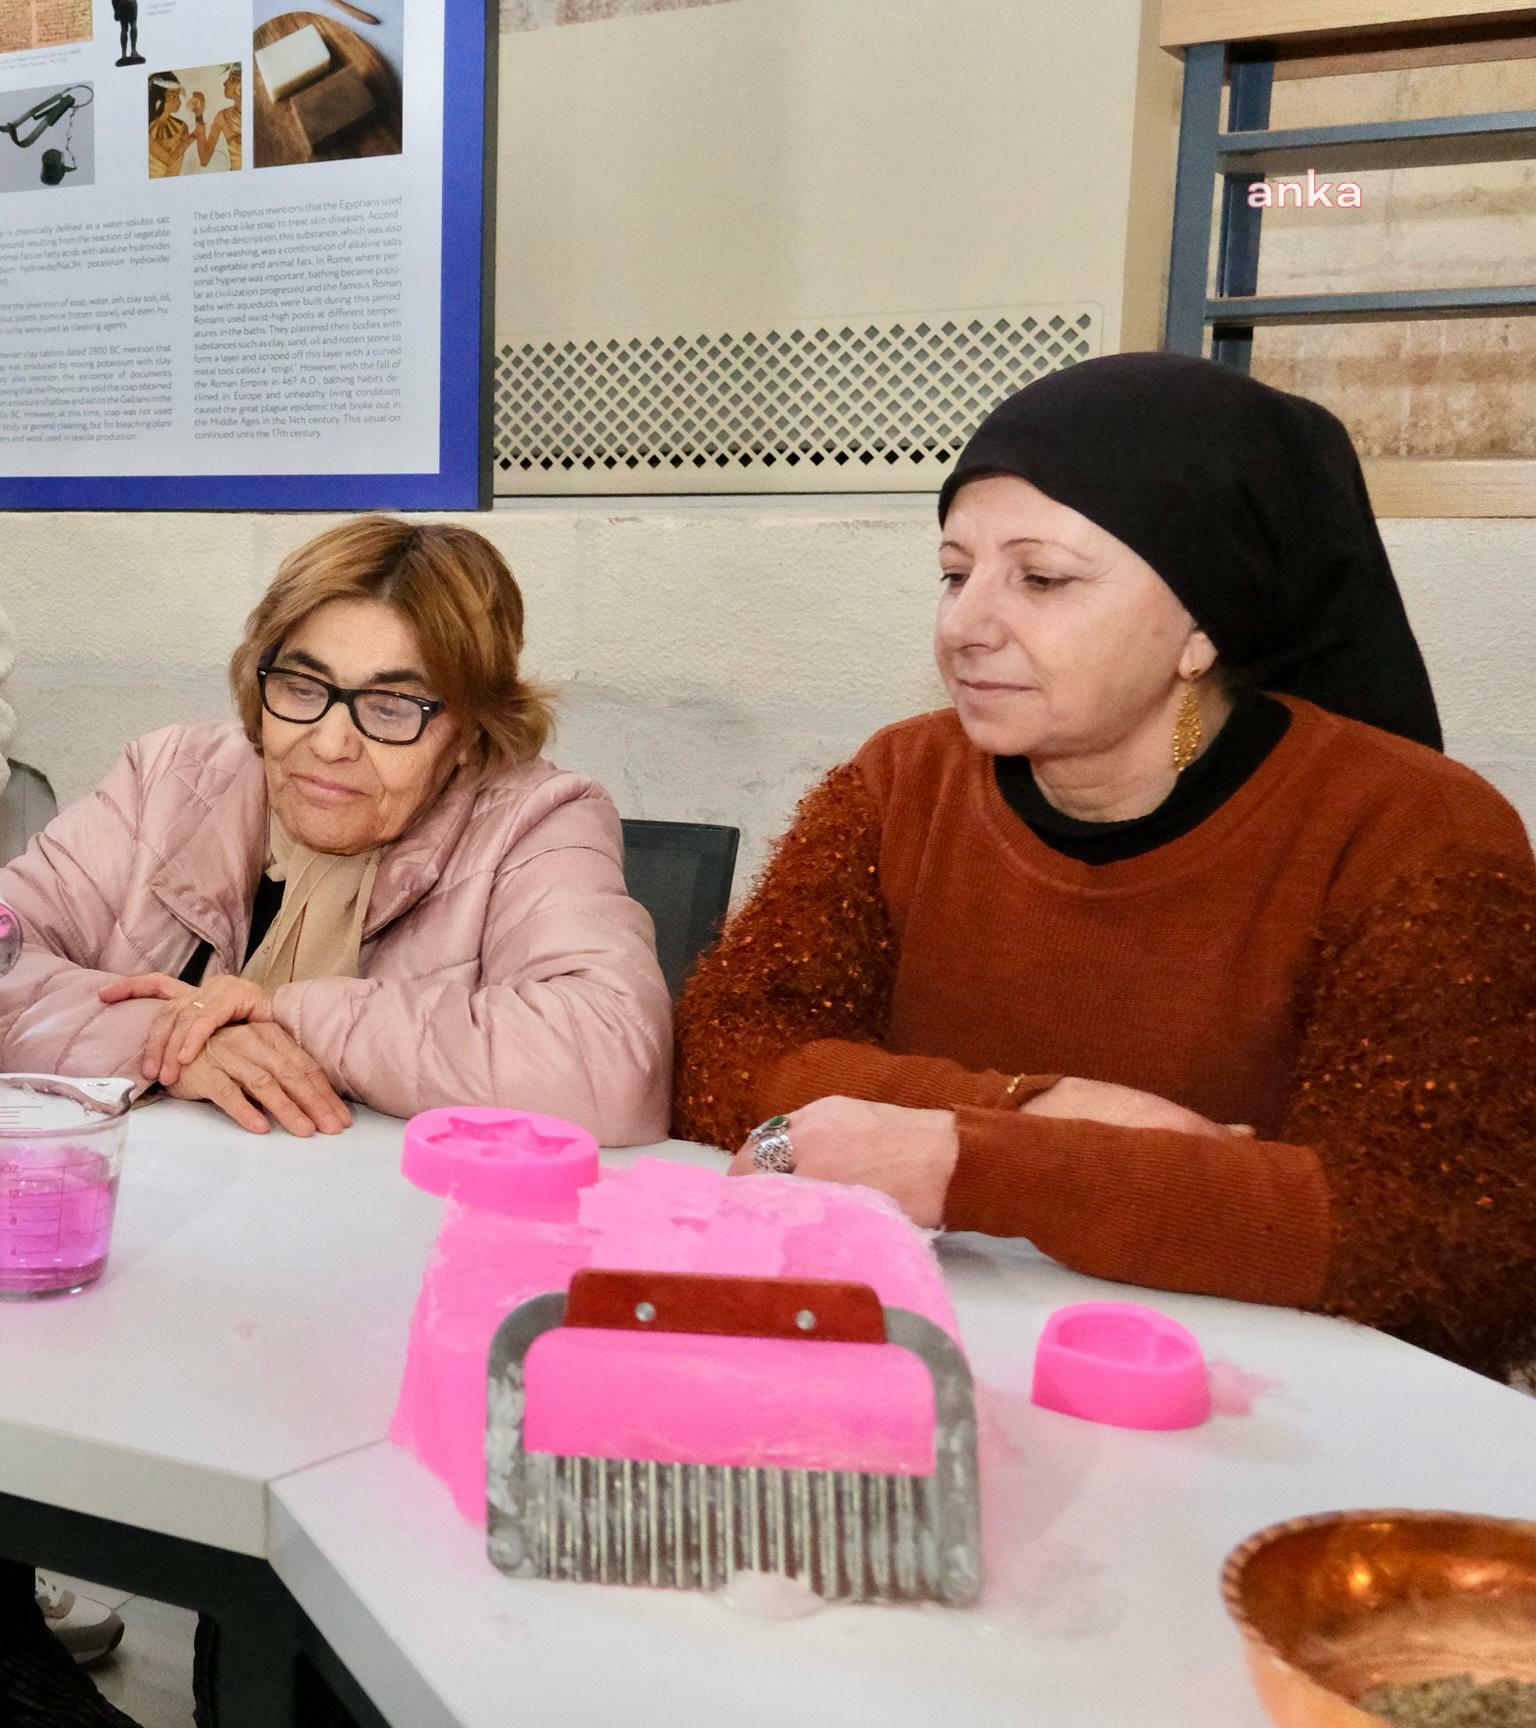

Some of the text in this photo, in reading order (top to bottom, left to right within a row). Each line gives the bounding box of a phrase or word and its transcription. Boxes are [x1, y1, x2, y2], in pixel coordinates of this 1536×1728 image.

[193, 196, 402, 221] The Papyrus mentions that the Egyptians used
[199, 222, 239, 233] substance
[256, 221, 275, 231] soap
[277, 219, 287, 228] to
[288, 217, 308, 227] treat
[216, 236, 229, 245] the
[279, 231, 294, 241] this
[340, 226, 365, 236] which
[384, 223, 401, 233] also
[193, 250, 212, 260] used
[213, 249, 224, 258] for
[283, 241, 335, 254] combination
[337, 241, 346, 250] of
[193, 263, 208, 272] and
[209, 260, 248, 274] vegetable
[250, 259, 265, 269] and
[267, 258, 293, 268] animal
[315, 256, 324, 265] In
[354, 252, 380, 262] where
[193, 276, 213, 285] sonal
[216, 274, 246, 286] hygiene
[307, 268, 338, 281] bathing
[340, 266, 373, 277] became
[193, 289, 203, 298] lar
[260, 283, 304, 297] progressed
[306, 282, 321, 292] and
[323, 282, 337, 291] the
[339, 280, 370, 290] famous
[372, 278, 402, 288] Roman
[193, 302, 215, 311] baths
[216, 300, 234, 310] with
[236, 298, 278, 311] aqueducts
[302, 296, 322, 305] built
[324, 294, 351, 307] during
[353, 293, 369, 303] this
[193, 314, 224, 324] Romans
[226, 313, 246, 322] used
[291, 309, 315, 321] pools
[317, 310, 325, 318] at
[327, 307, 364, 317] different
[219, 327, 228, 336] in
[228, 326, 242, 335] the
[269, 324, 288, 336] They
[290, 322, 328, 335] plastered
[330, 321, 349, 330] their
[352, 320, 380, 330] bodies
[382, 318, 401, 328] with
[194, 339, 236, 350] substances
[238, 338, 256, 348] such
[321, 335, 337, 344] and
[339, 334, 365, 343] rotten
[366, 333, 390, 342] stone
[391, 333, 401, 341] to
[193, 353, 212, 362] form
[220, 352, 239, 364] layer
[241, 351, 256, 360] and
[258, 350, 290, 362] scraped
[291, 350, 303, 358] off
[305, 349, 321, 358] this
[322, 348, 343, 360] layer
[344, 347, 363, 356] with
[372, 346, 401, 356] curved
[194, 366, 215, 375] metal
[217, 365, 233, 374] tool
[235, 364, 260, 374] called
[339, 361, 358, 370] with
[360, 360, 374, 369] the
[375, 360, 389, 369] fall
[391, 359, 401, 368] of
[194, 379, 207, 388] the
[210, 378, 237, 387] Roman
[240, 377, 268, 389] Empire
[271, 377, 279, 385] in
[323, 374, 354, 386] bathing
[357, 373, 383, 383] habits
[194, 386, 400, 402] clined in Europe and unhealthy living conditions
[194, 400, 400, 414] caused the great plague epidemic that broke out in
[194, 417, 207, 426] the
[210, 417, 237, 426] Middle
[240, 416, 259, 427] Ages
[262, 417, 270, 425] in
[272, 416, 285, 424] the
[343, 414, 360, 423] This
[363, 414, 400, 422] situation
[194, 428, 288, 439] continued until the 17th
